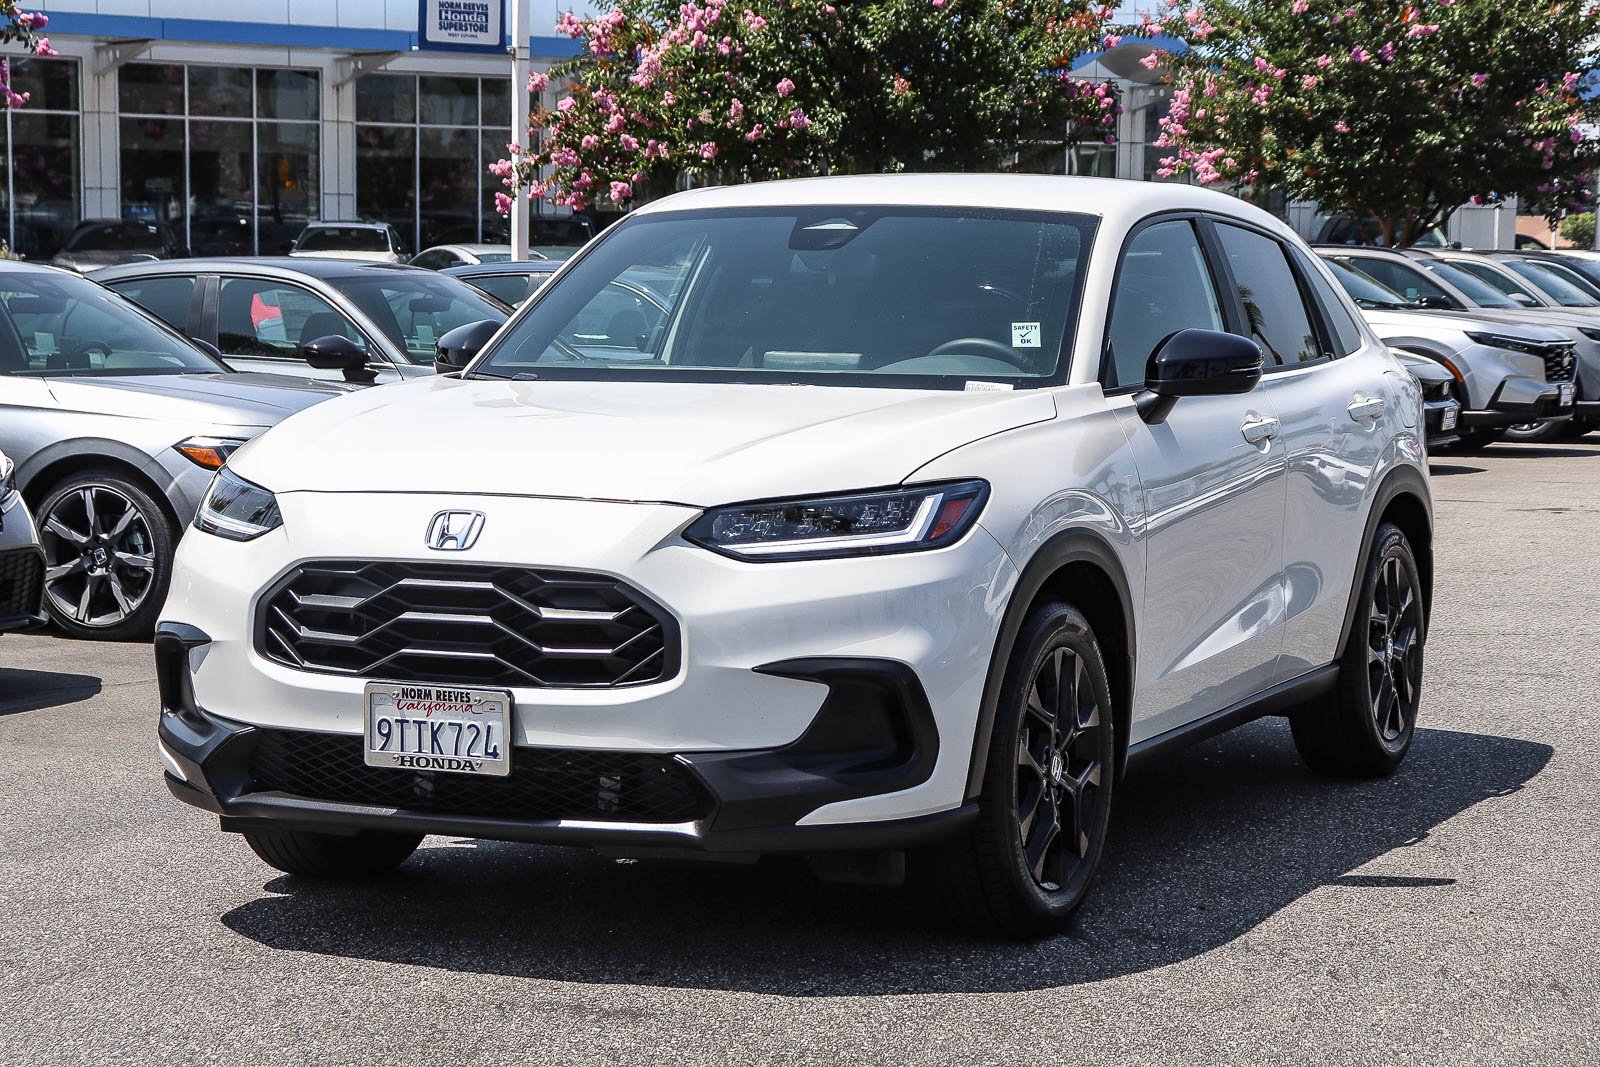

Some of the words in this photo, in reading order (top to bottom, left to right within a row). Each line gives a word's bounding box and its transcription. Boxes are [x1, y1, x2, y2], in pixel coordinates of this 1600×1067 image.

[439, 1, 461, 9] NORM
[463, 3, 489, 11] REEVES
[441, 9, 486, 22] Honda
[438, 21, 489, 33] SUPERSTORE
[401, 687, 433, 700] NORM
[435, 690, 471, 703] REEVES
[396, 699, 483, 718] California
[377, 717, 500, 759] 9TIK724
[398, 755, 478, 772] HONDA
